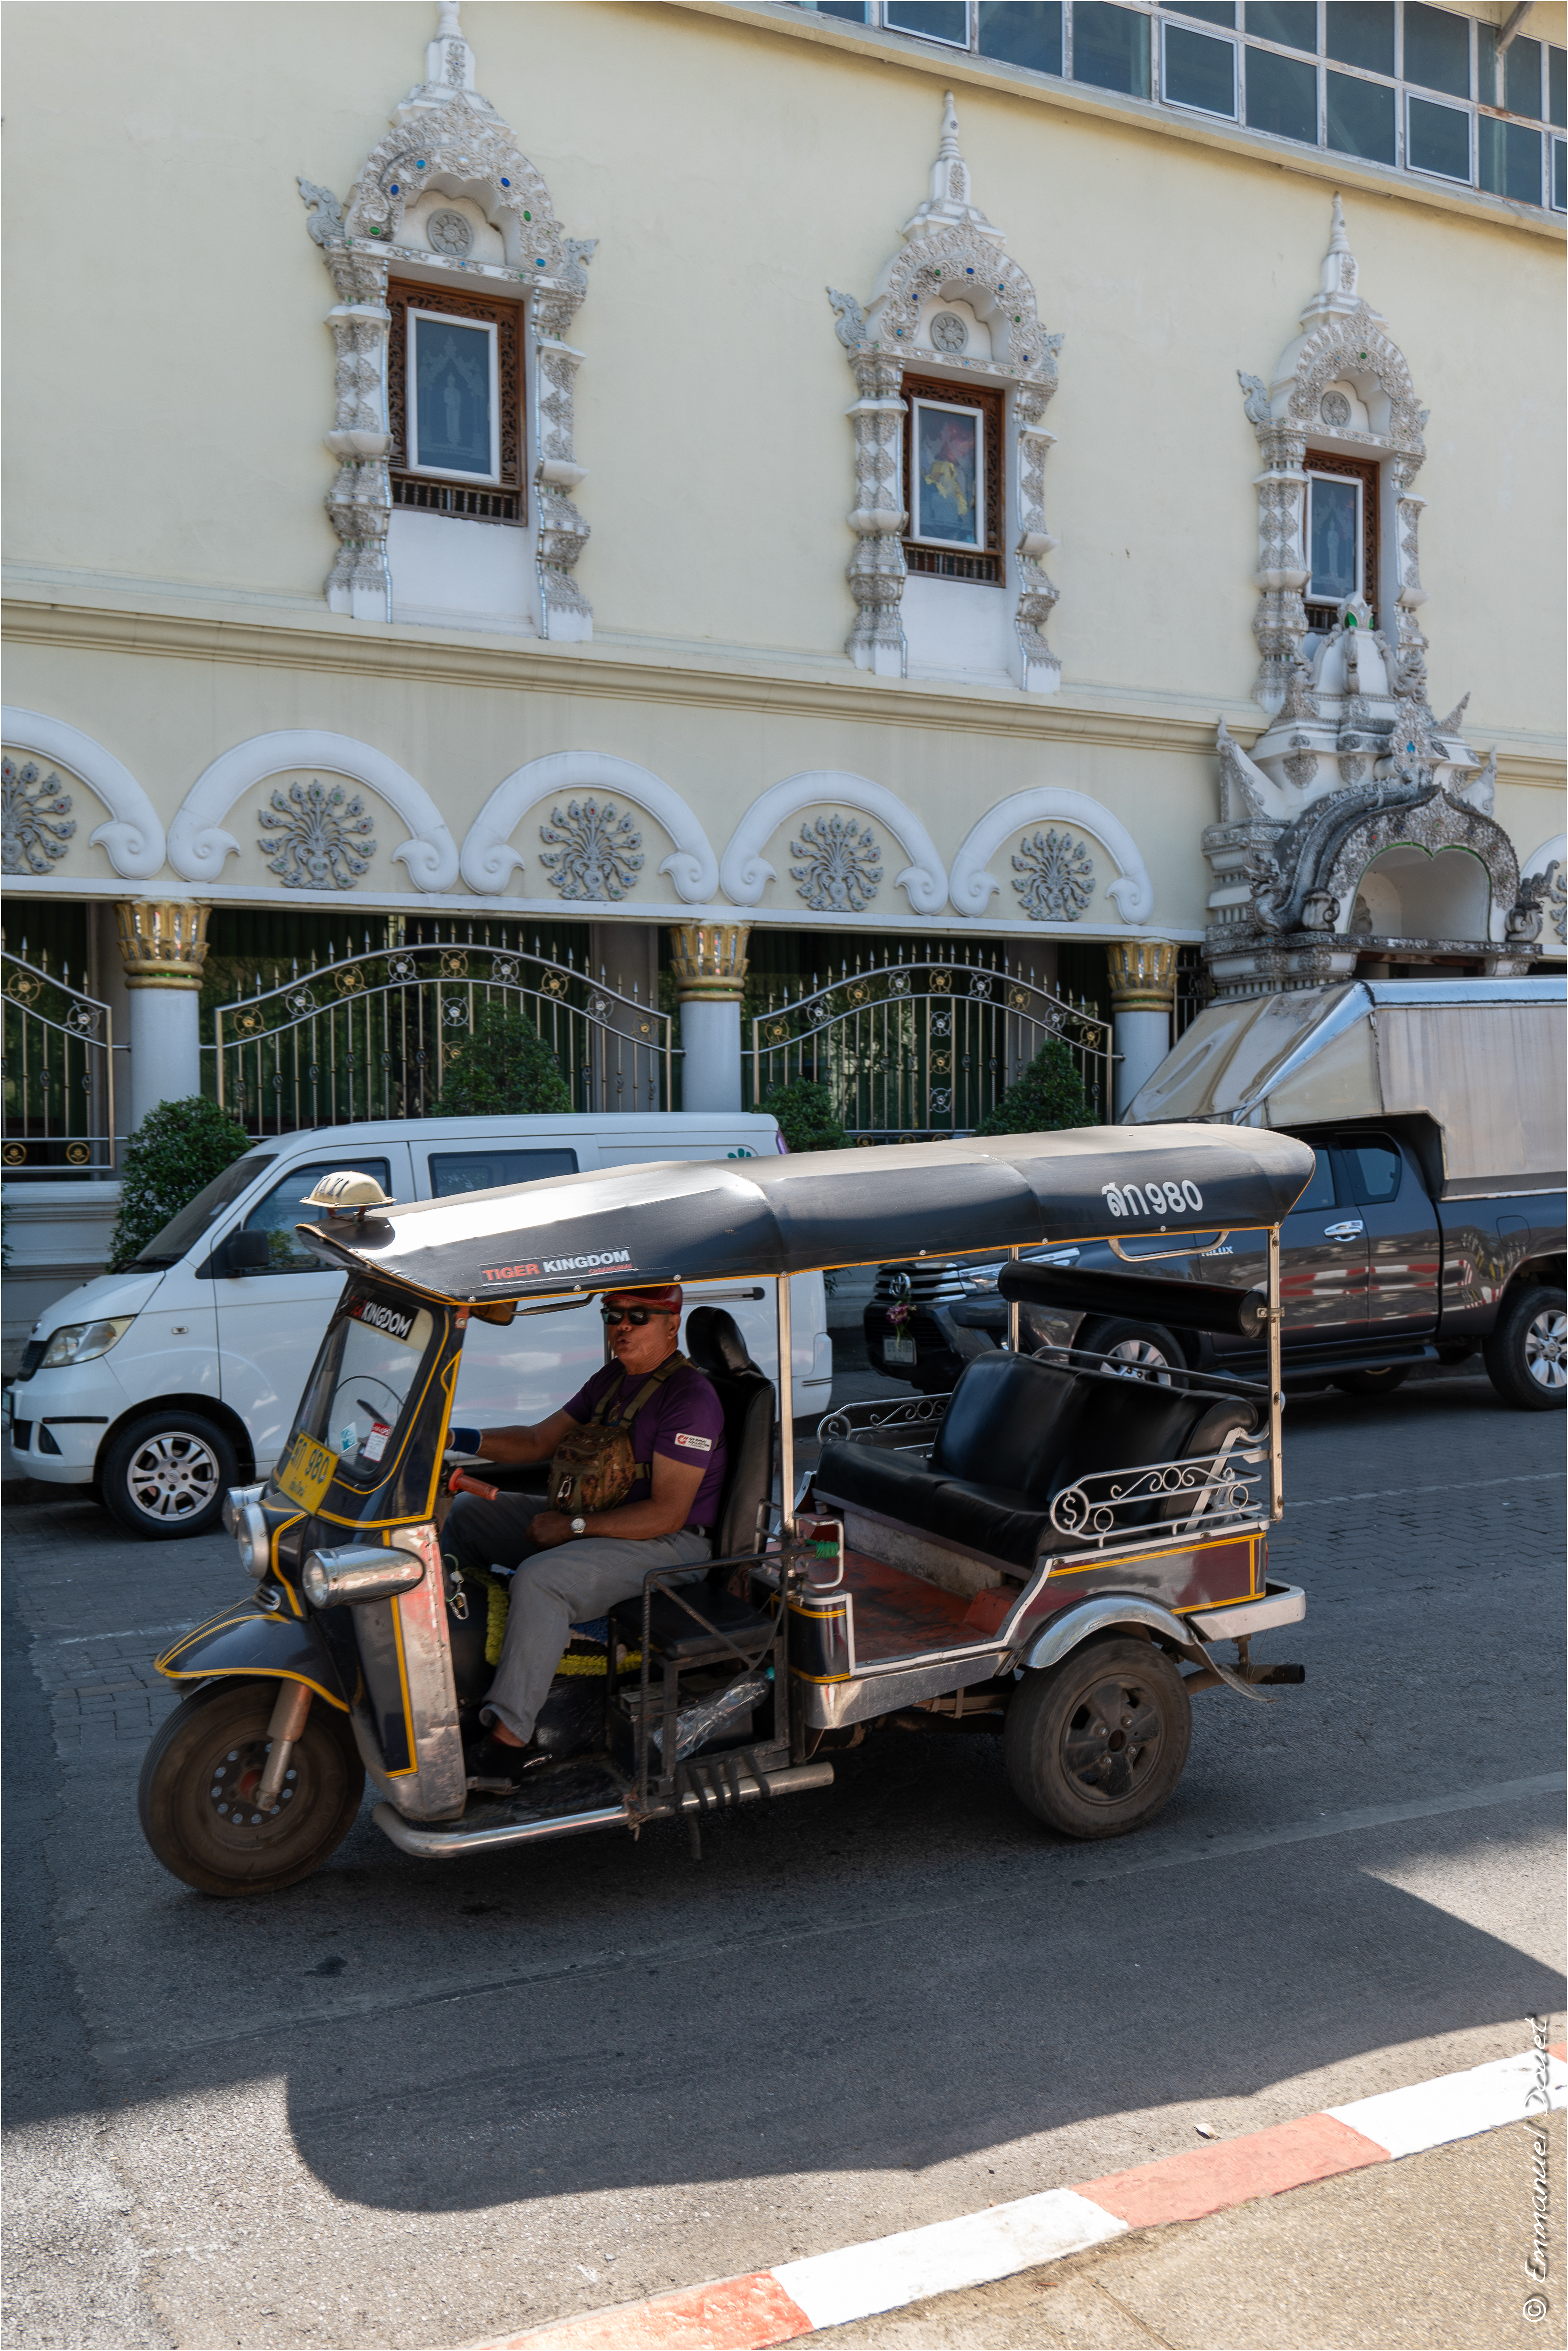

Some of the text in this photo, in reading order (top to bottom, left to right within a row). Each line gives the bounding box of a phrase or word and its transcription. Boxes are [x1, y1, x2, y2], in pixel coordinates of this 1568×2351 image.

[482, 1250, 631, 1280] TIGER KINGDOM
[361, 1301, 413, 1337] KINGDOM
[305, 1448, 331, 1484] 980
